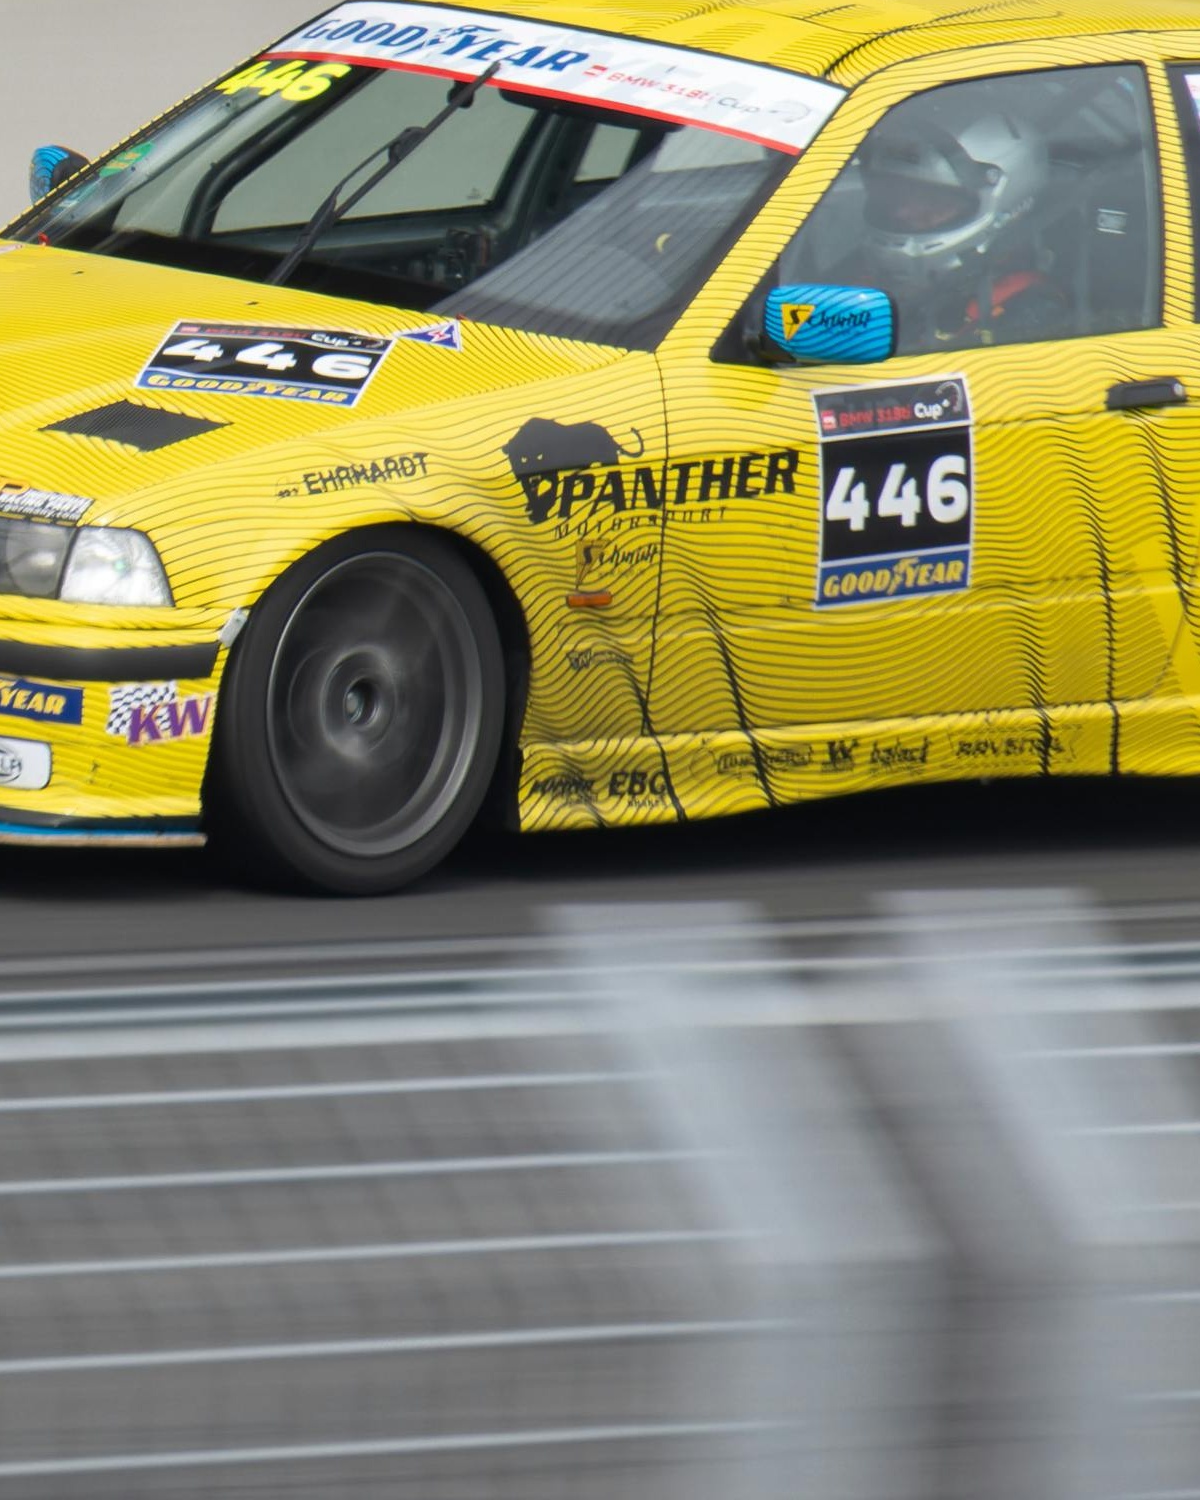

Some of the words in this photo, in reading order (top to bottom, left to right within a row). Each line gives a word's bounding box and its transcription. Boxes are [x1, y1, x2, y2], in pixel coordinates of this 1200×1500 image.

[302, 19, 590, 73] GOODYEAR
[214, 60, 352, 101] 446
[718, 97, 760, 113] Cup
[162, 339, 373, 379] 446
[311, 332, 351, 347] Cup
[147, 374, 349, 403] GOODYEAR
[913, 402, 943, 420] Cup
[303, 452, 430, 495] EHRHARDT
[558, 447, 799, 519] PANTHER
[826, 454, 969, 531] 446
[823, 557, 965, 598] GOODYEAR
[127, 694, 212, 745] KW
